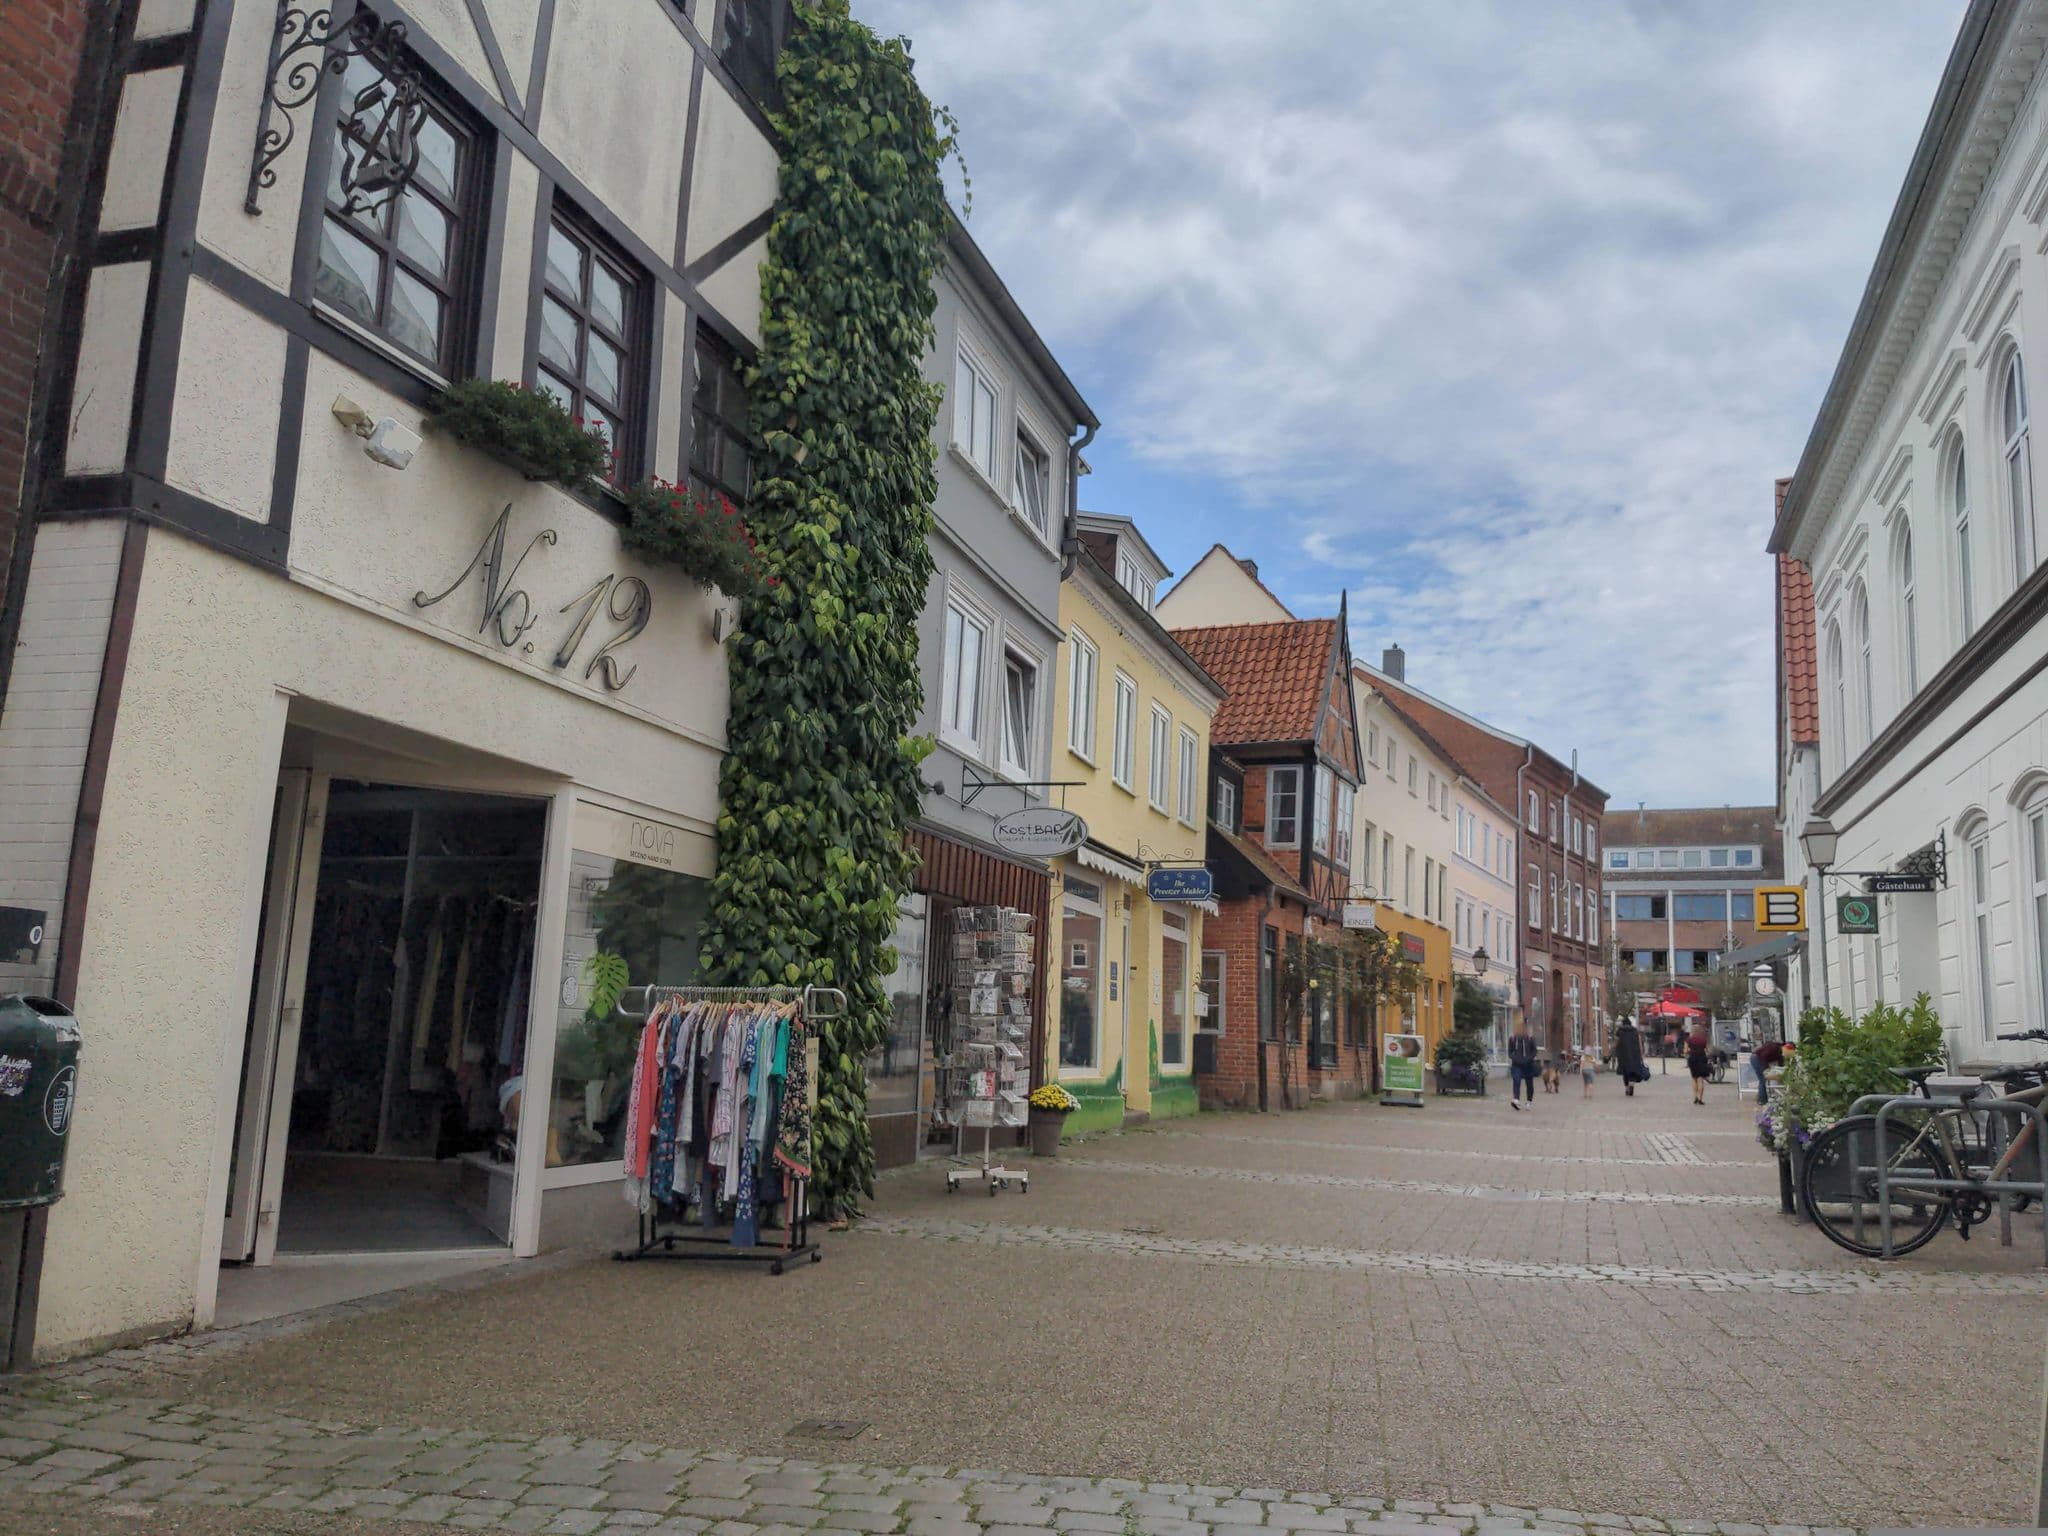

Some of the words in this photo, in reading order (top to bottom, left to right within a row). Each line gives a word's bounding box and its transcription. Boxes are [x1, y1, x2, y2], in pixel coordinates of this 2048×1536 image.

[411, 502, 557, 654] No.
[552, 573, 653, 691] 12
[630, 850, 647, 860] SECOND
[647, 855, 659, 863] HAND
[660, 857, 672, 866] STORE
[1876, 881, 1926, 891] Gästehaus
